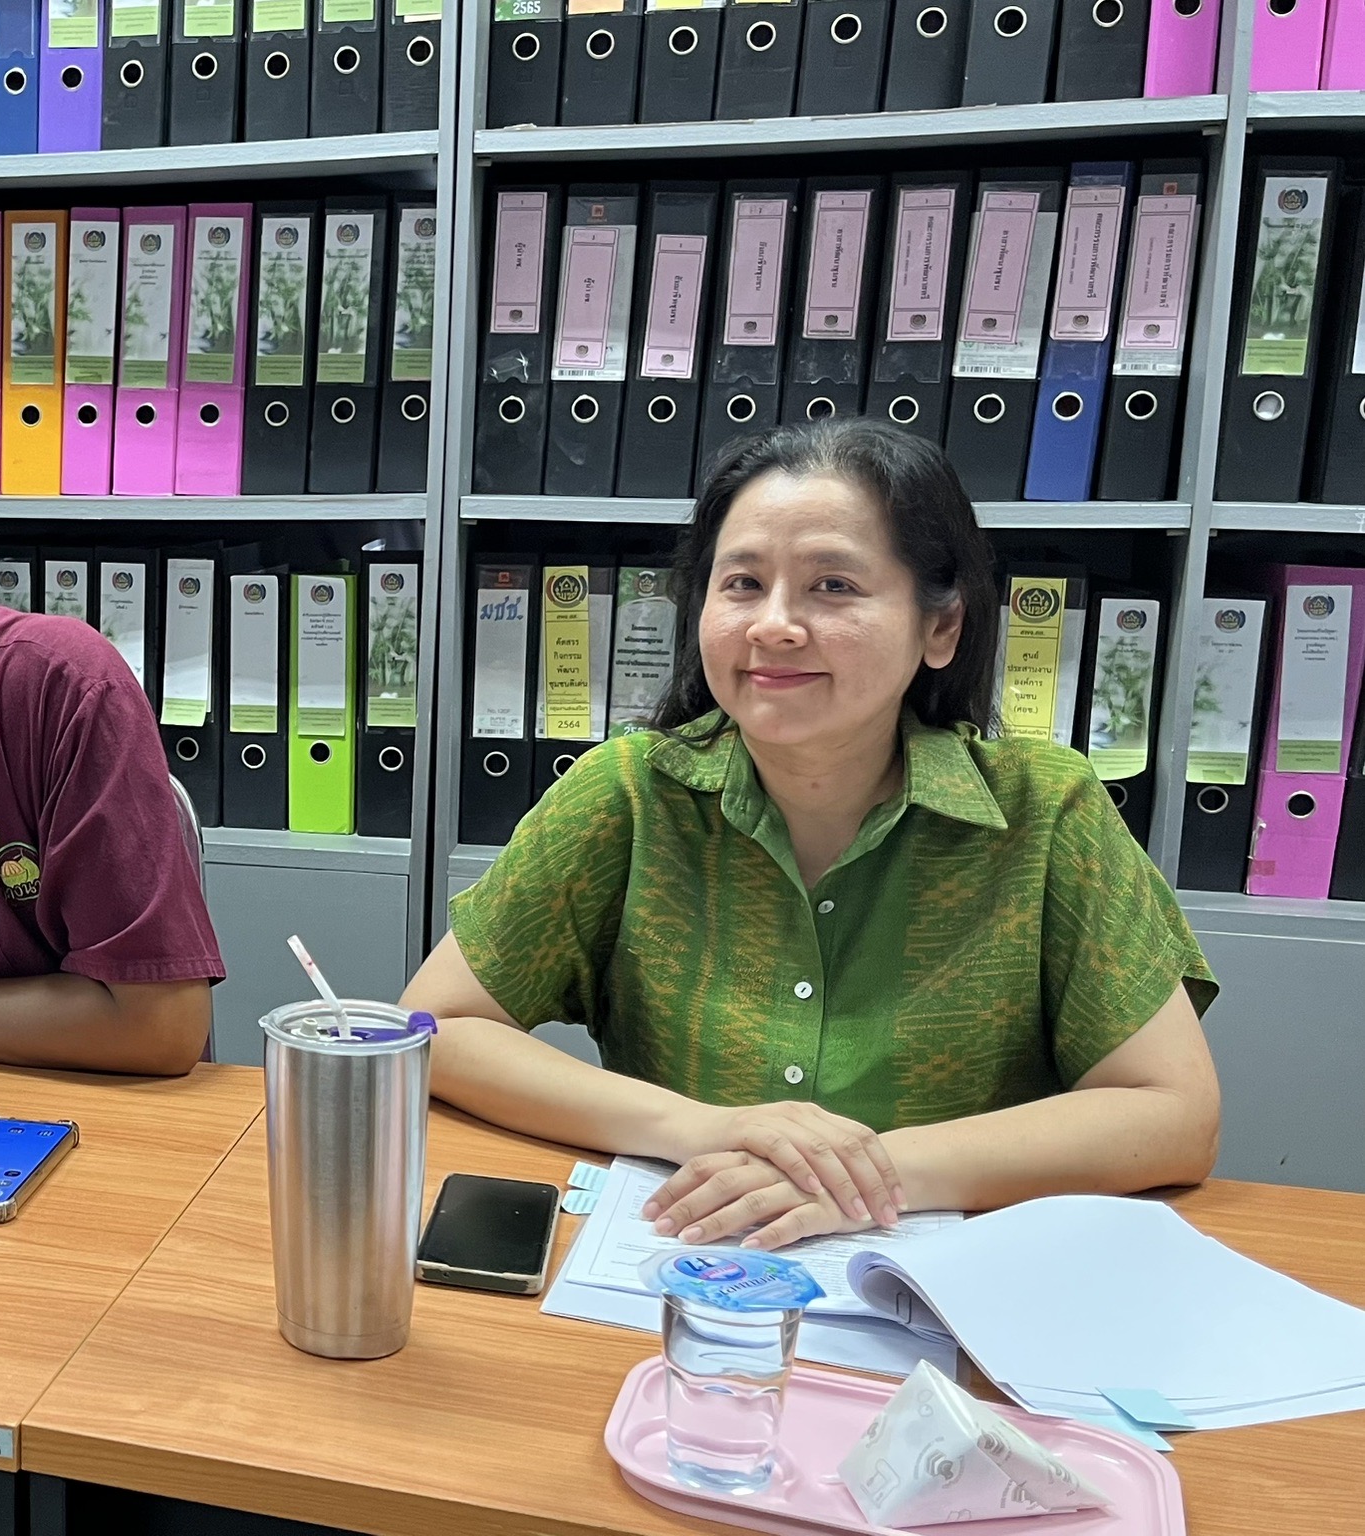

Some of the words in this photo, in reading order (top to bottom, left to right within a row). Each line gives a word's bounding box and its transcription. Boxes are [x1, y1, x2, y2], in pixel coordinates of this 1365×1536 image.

[513, 1, 540, 15] 2565
[553, 651, 582, 660] กิจกรรม
[1022, 651, 1039, 661] ศูนย์
[556, 665, 580, 673] พัฒนา
[1007, 664, 1052, 674] ประสานงาน
[549, 679, 588, 690] ชุมชนดีเด่น
[558, 720, 580, 729] 2564
